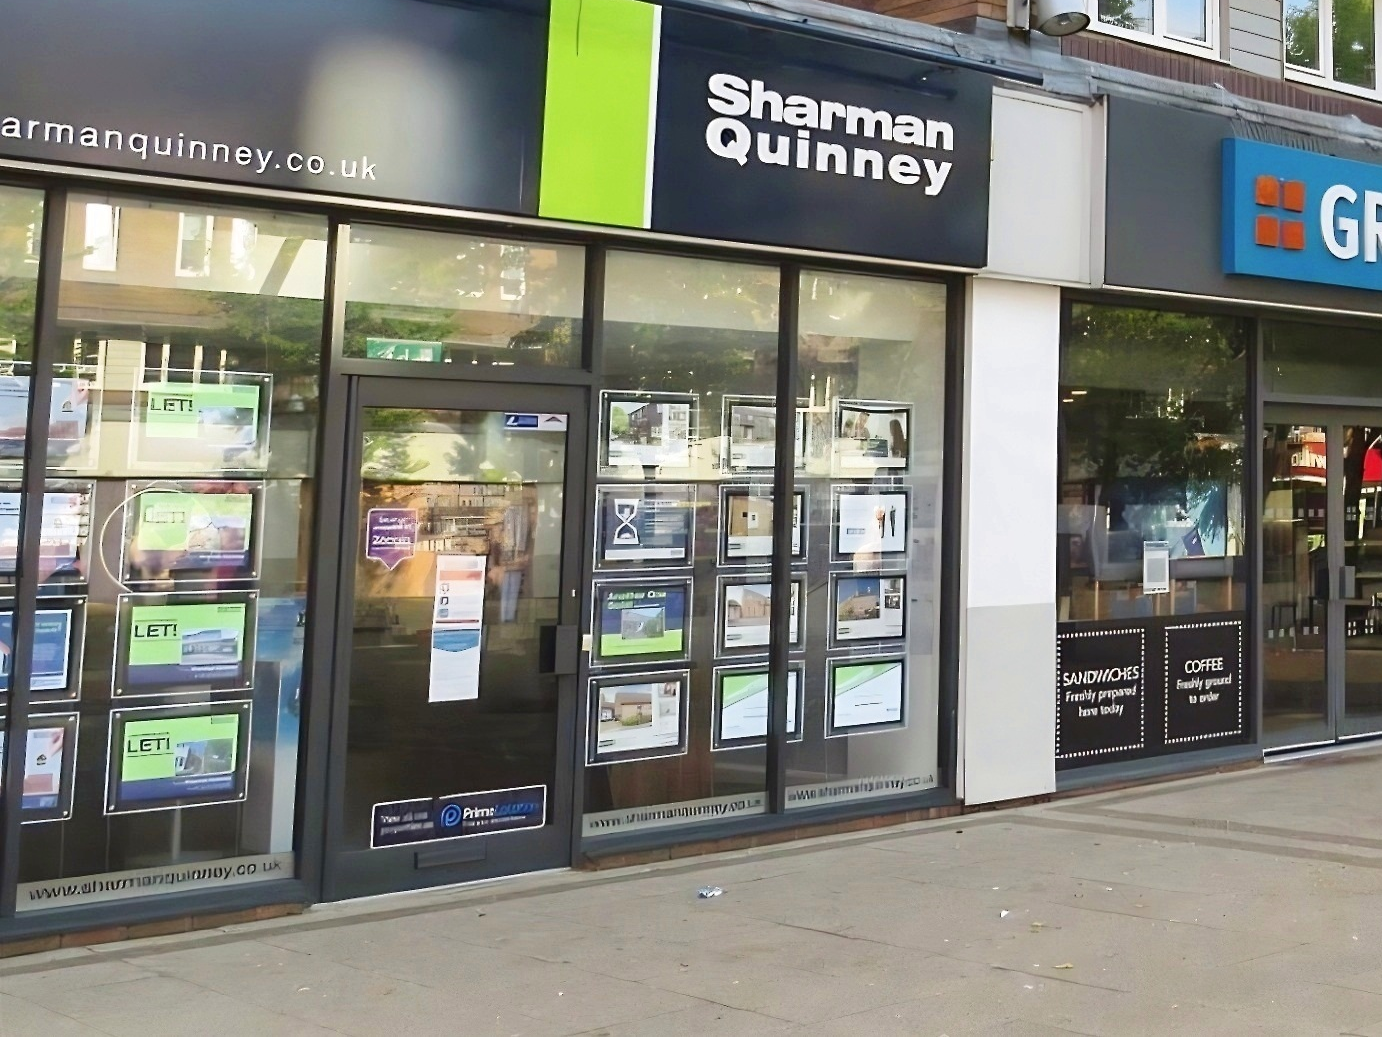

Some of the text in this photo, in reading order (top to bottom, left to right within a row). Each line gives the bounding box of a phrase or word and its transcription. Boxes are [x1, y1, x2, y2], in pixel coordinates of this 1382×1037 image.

[707, 73, 954, 151] Sharman
[705, 116, 953, 196] Quinney
[134, 623, 178, 639] LET!
[1184, 657, 1224, 674] COFFEE
[1063, 666, 1140, 686] SANDWICHES
